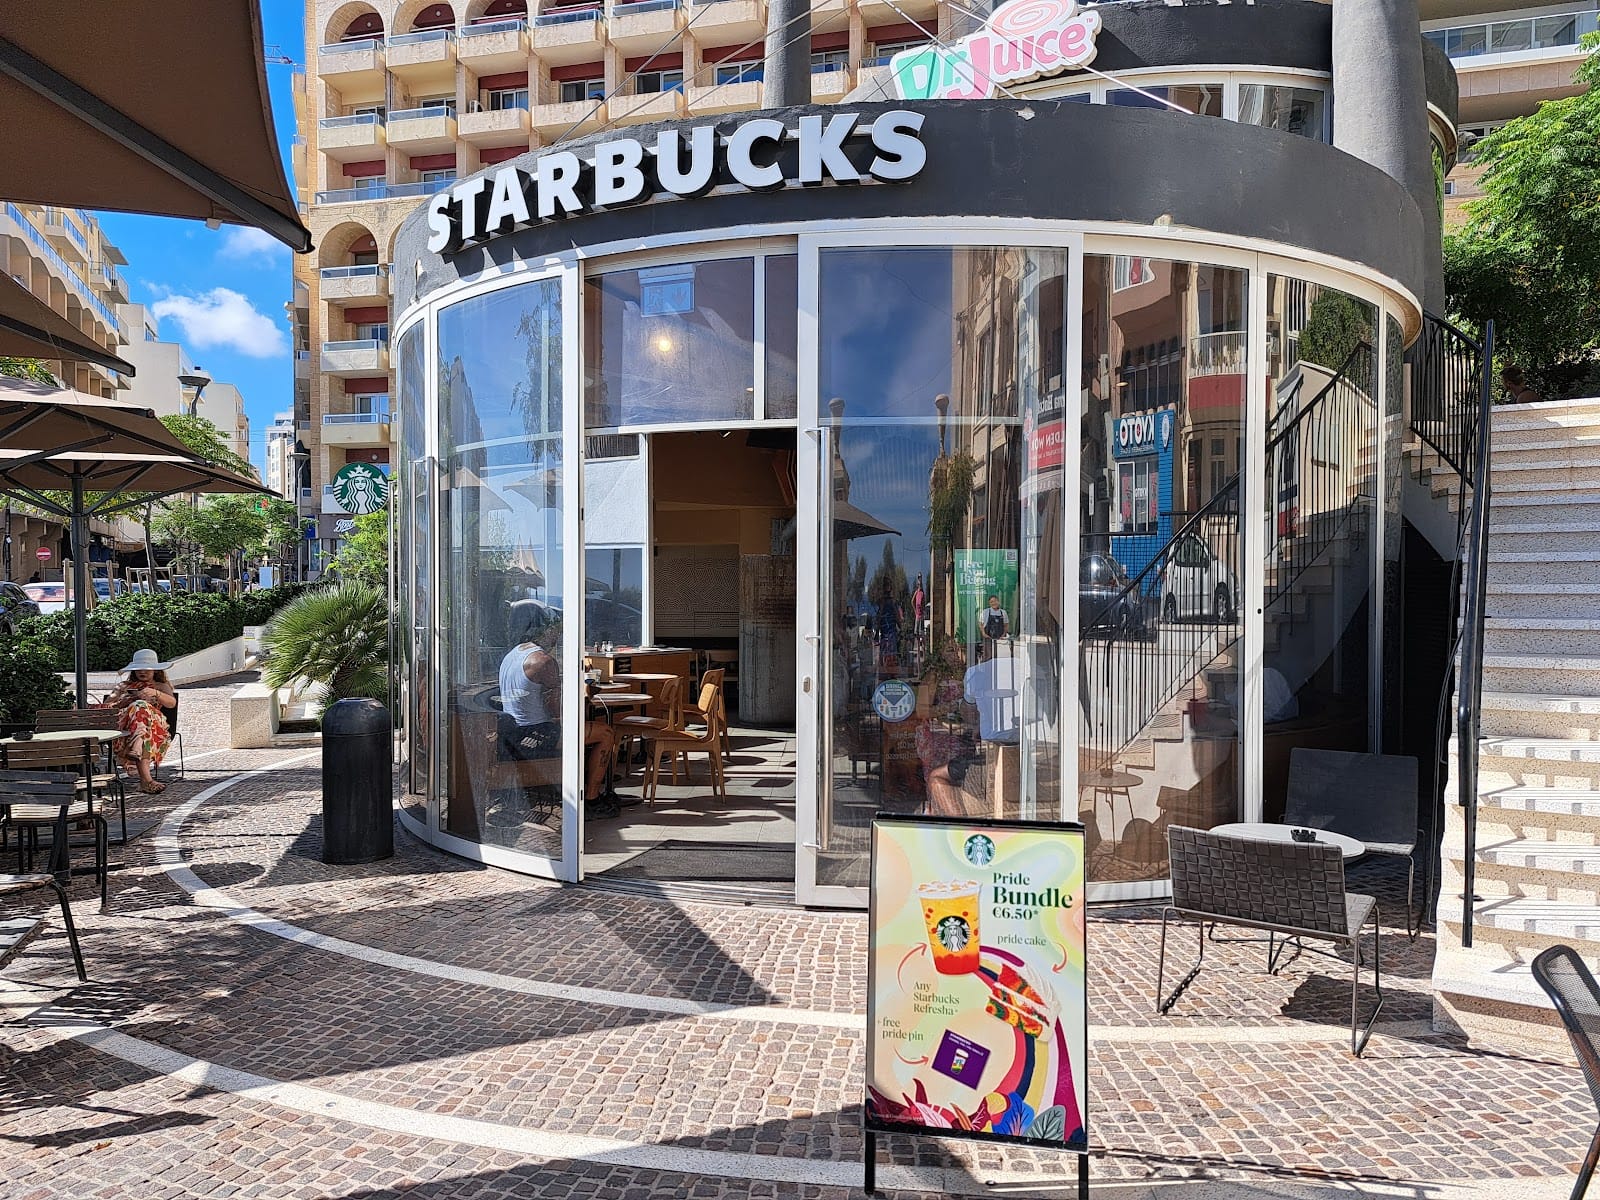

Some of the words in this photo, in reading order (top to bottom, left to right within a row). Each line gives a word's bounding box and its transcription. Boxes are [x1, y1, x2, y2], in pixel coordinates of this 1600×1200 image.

[427, 111, 927, 253] STARBUCKS
[993, 872, 1030, 885] Pride
[993, 886, 1073, 908] Bundle
[997, 934, 1023, 945] pride
[1024, 936, 1047, 946] cake
[913, 981, 931, 992] Any
[913, 992, 960, 1005] Starbucks
[882, 1016, 901, 1028] free
[882, 1029, 908, 1040] pride
[908, 1031, 924, 1042] pin
